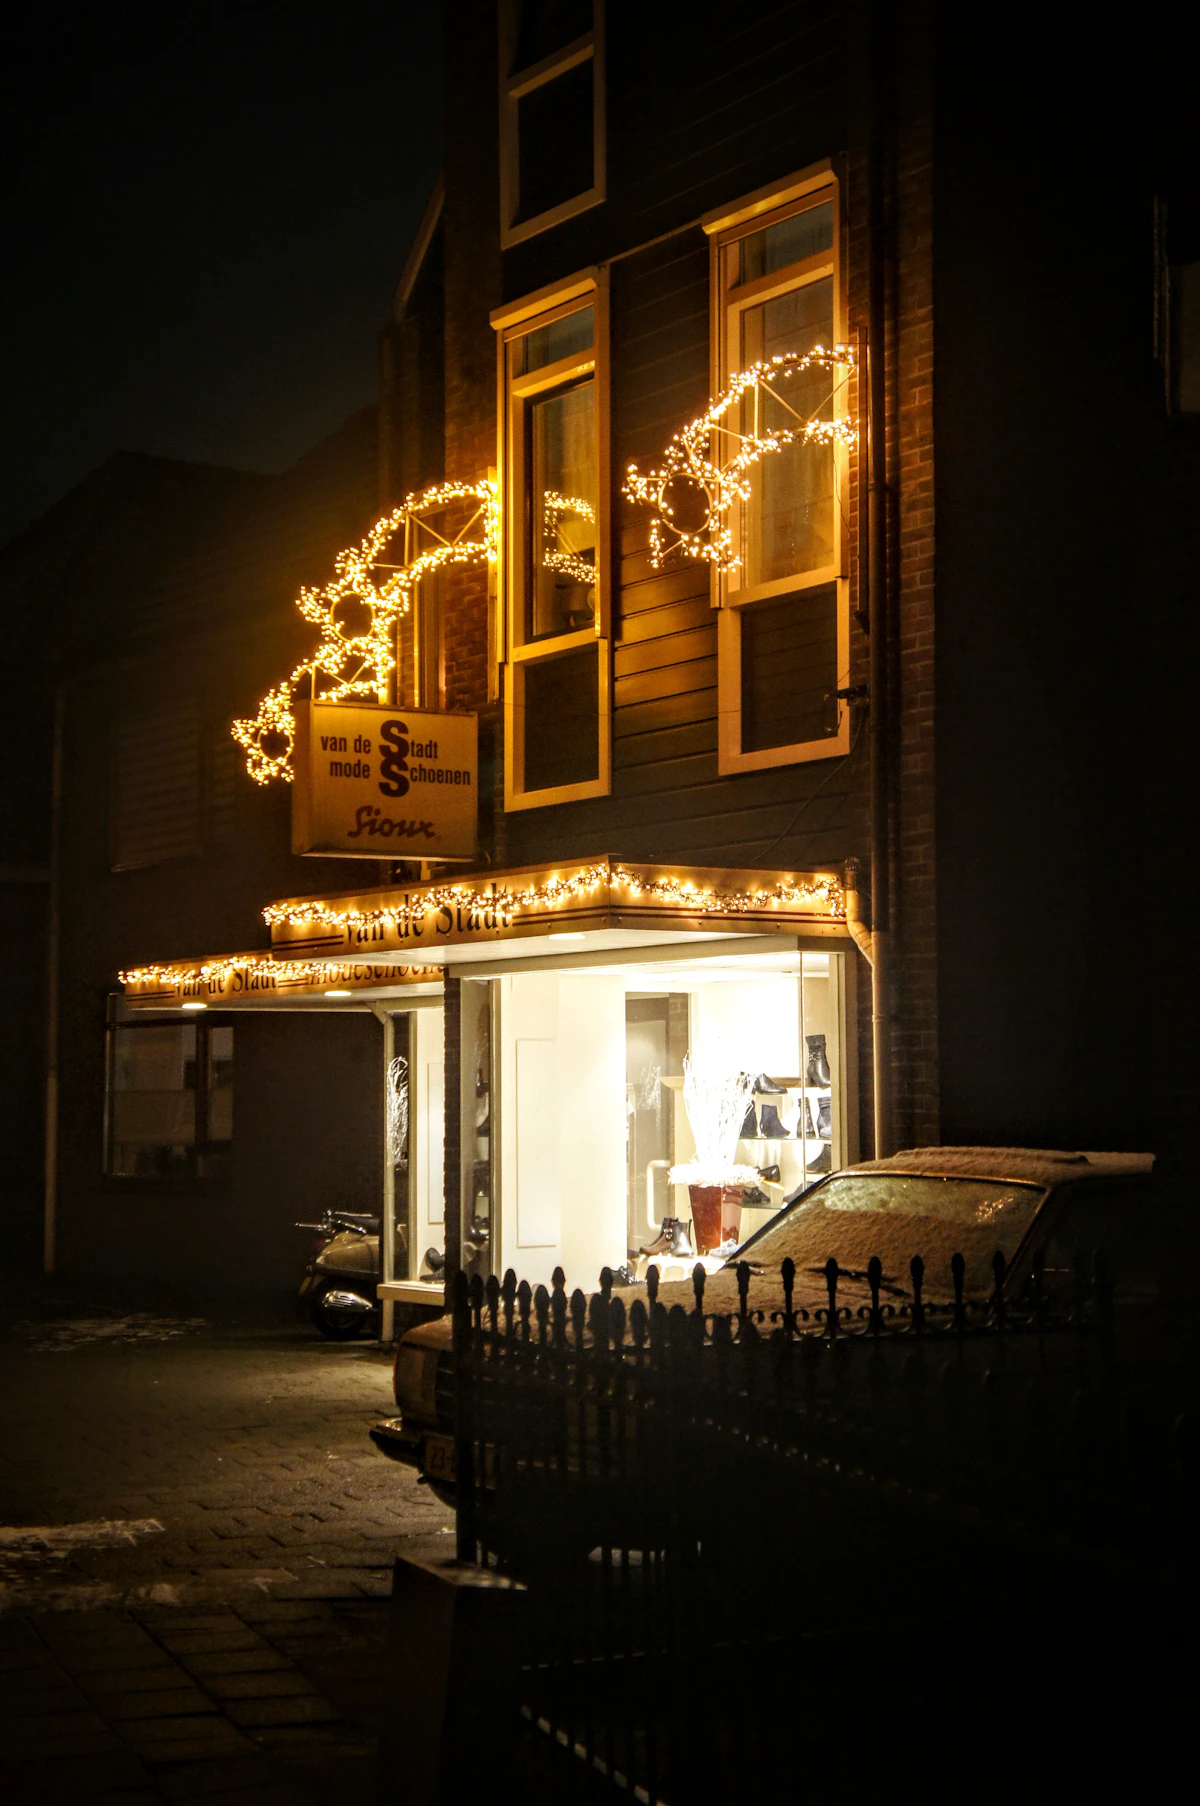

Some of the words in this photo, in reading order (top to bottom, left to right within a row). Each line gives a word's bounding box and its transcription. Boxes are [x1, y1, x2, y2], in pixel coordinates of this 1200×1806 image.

[321, 735, 347, 753] van
[353, 734, 371, 754] de
[378, 719, 438, 759] Stadt
[329, 759, 371, 779] mode
[378, 757, 471, 798] Schoenen
[347, 805, 436, 839] Sioux
